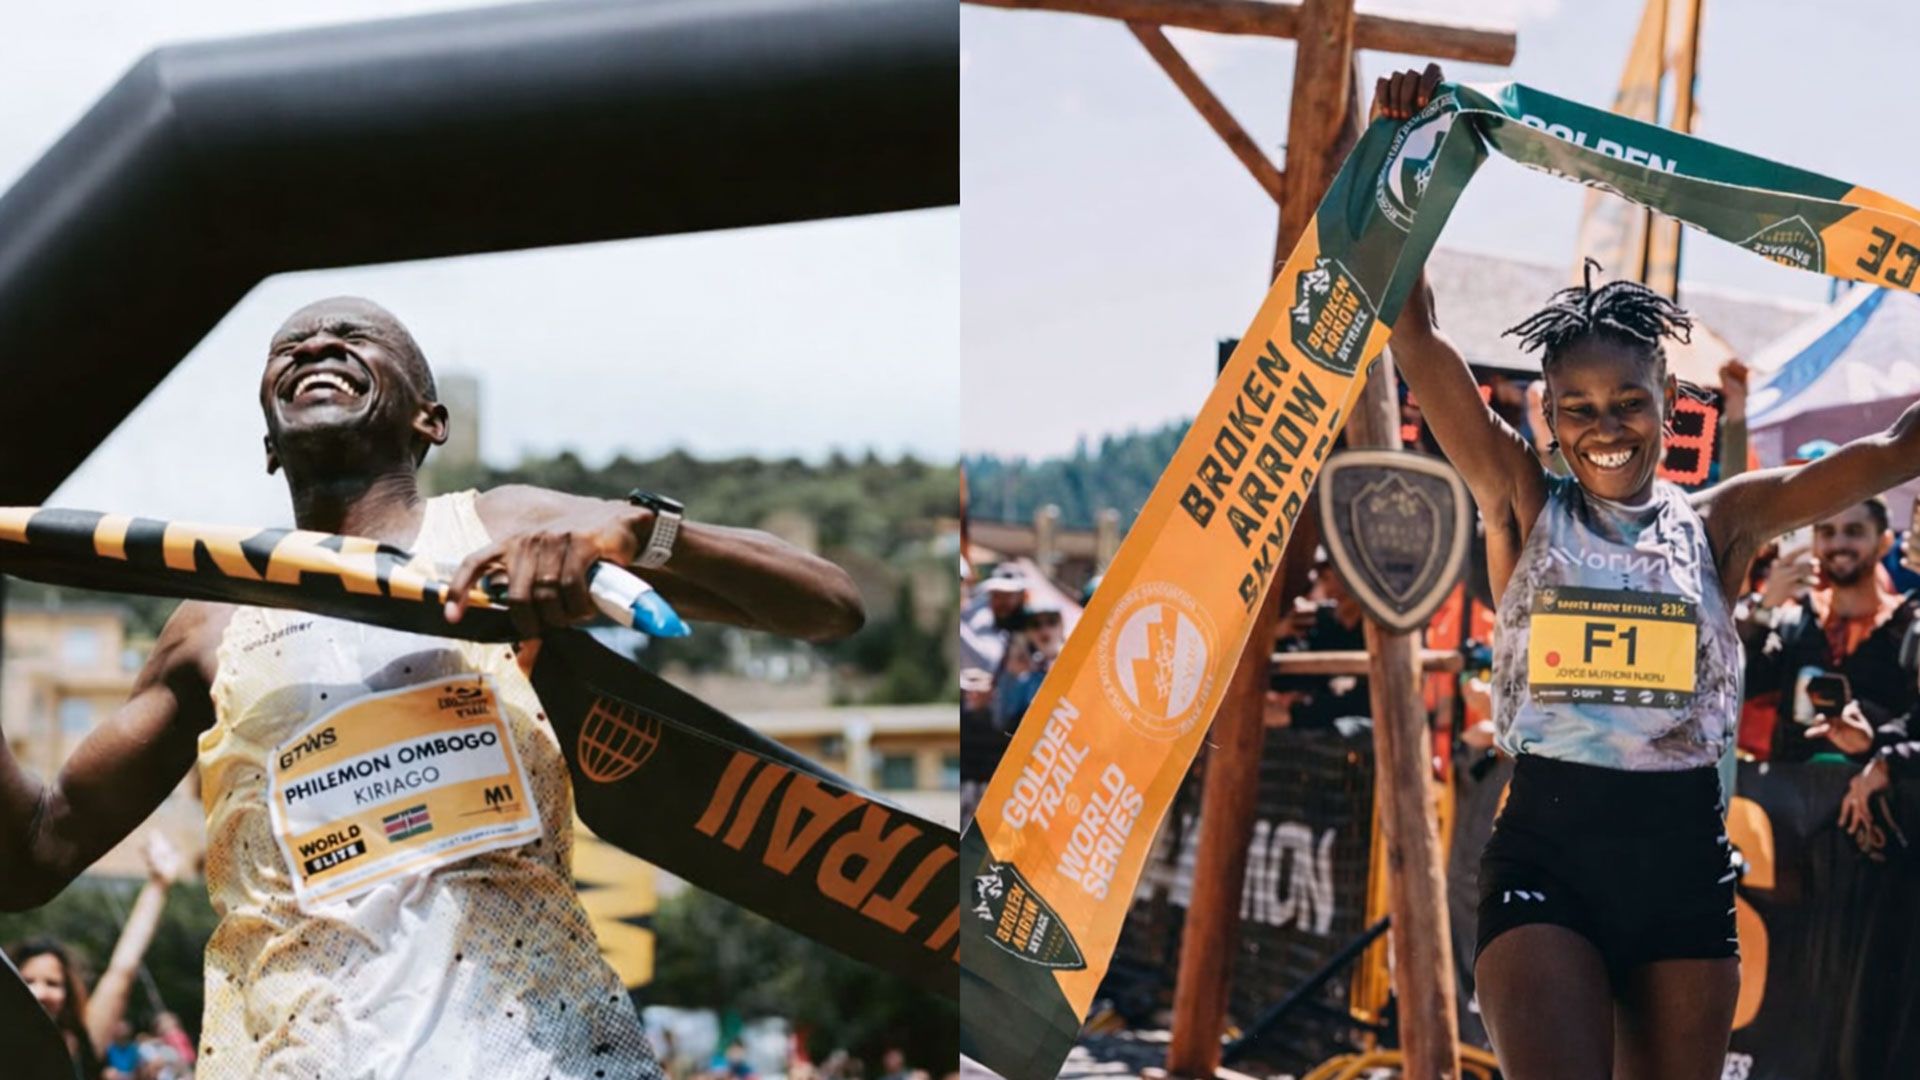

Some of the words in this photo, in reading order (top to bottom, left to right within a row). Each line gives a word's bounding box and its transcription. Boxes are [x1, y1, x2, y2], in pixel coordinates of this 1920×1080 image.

[1307, 274, 1349, 350] BROKEN
[1322, 291, 1360, 359] ARROW
[1179, 340, 1291, 529] BROKEN
[1226, 372, 1327, 548] ARROW
[1584, 622, 1637, 666] F1
[279, 727, 338, 771] GTWS
[284, 753, 392, 804] PHILEMON
[397, 731, 497, 764] OMBOGO
[354, 766, 440, 805] KIRIAGO
[1002, 696, 1081, 831] GOLDEN
[483, 785, 514, 806] M1
[1030, 742, 1090, 831] TRAIL
[1056, 762, 1127, 883] WORLD
[298, 824, 361, 858] WORLD
[1081, 785, 1145, 902] SERIES
